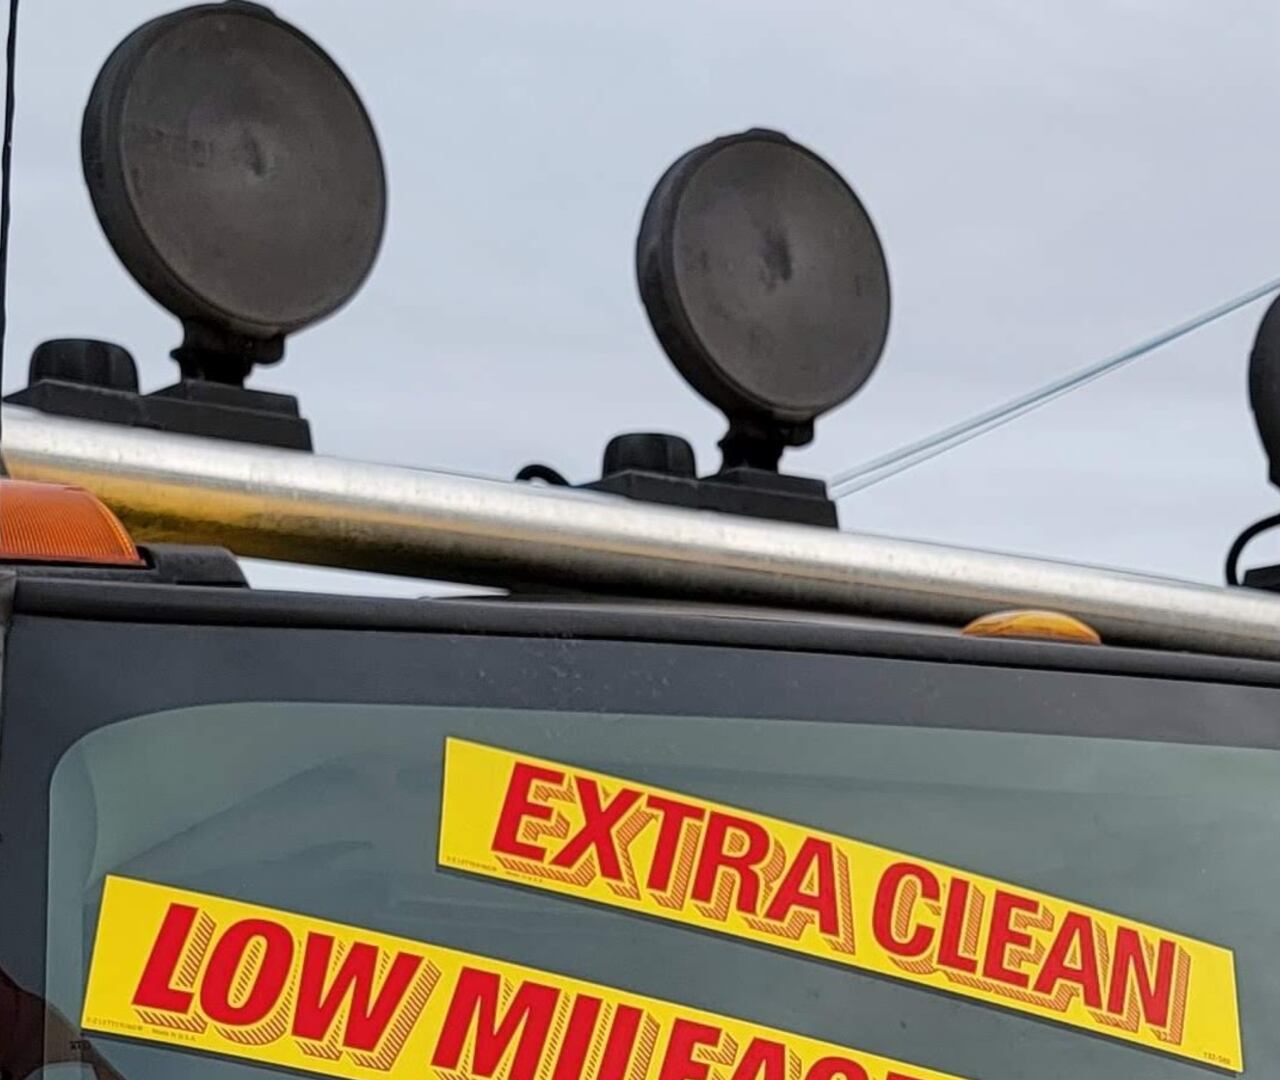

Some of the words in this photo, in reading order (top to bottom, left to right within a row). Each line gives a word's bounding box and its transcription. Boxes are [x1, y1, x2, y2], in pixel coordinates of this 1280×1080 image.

[131, 903, 441, 1071] LOW
[491, 762, 854, 954] EXTRA
[872, 862, 1191, 1045] CLEAN
